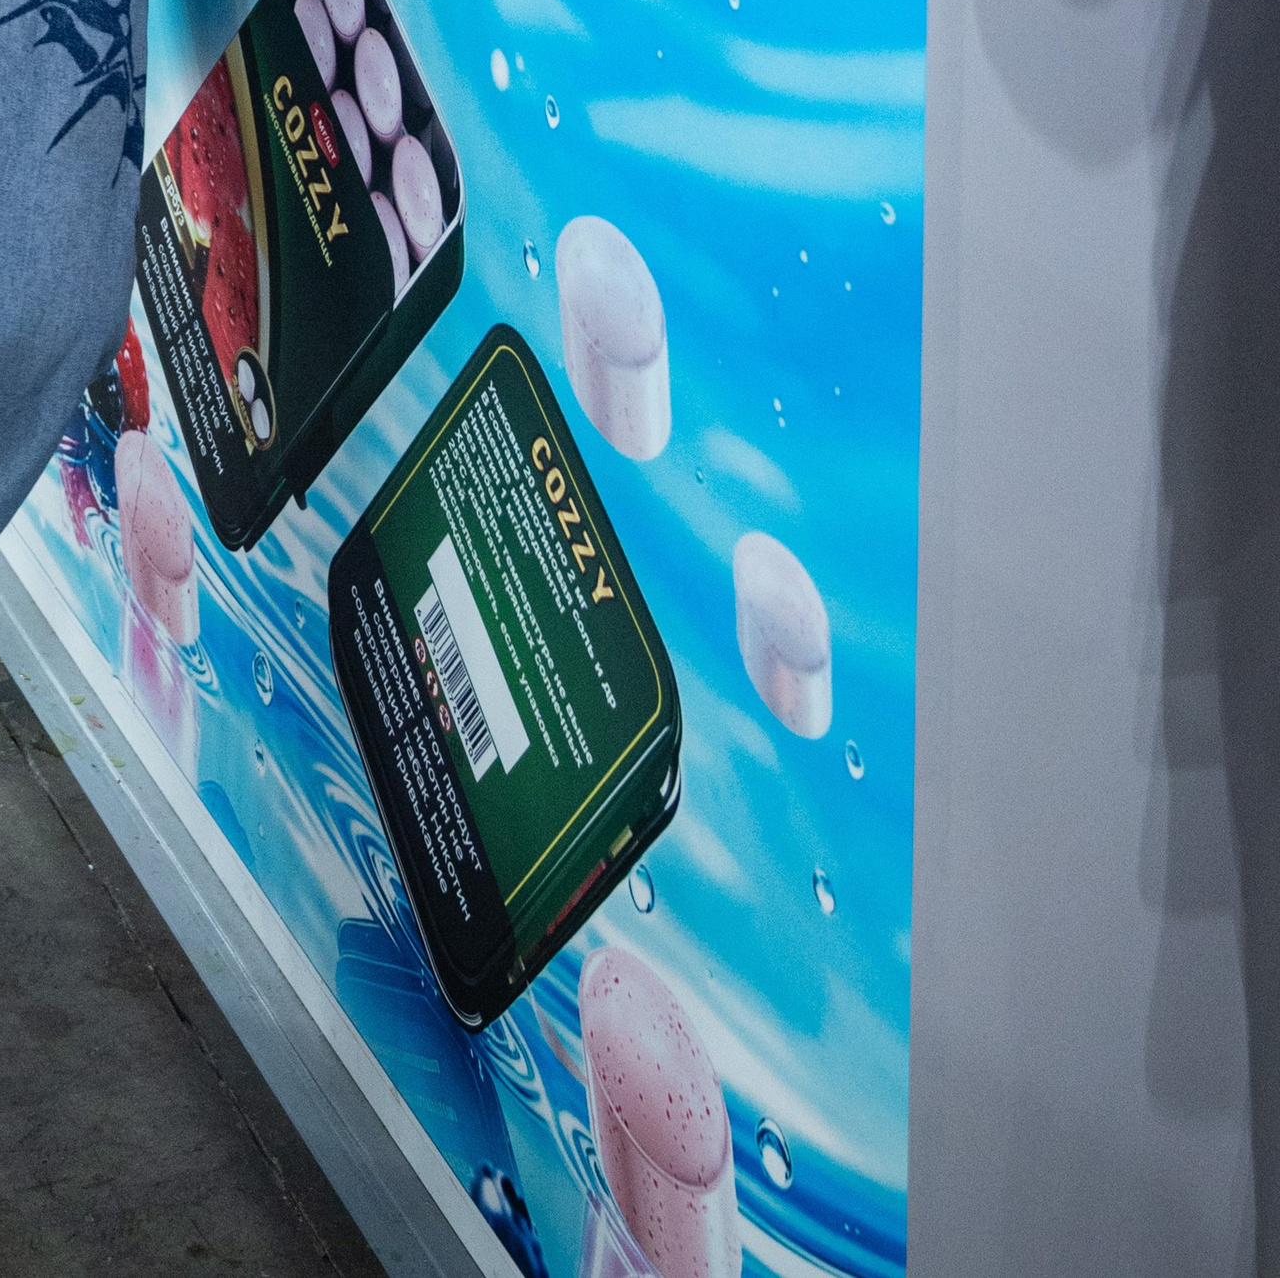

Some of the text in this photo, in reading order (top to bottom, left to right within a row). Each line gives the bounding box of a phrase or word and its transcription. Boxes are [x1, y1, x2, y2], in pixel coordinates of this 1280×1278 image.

[163, 170, 185, 229] арбуз
[263, 91, 332, 268] НИКОТИНОВЫЕ ЛЕДЕНЦЫ
[272, 74, 349, 244] COZZY
[140, 221, 179, 335] содержащий
[195, 393, 224, 476] Никотин
[142, 257, 207, 460] вызывает привыкание
[156, 240, 220, 431] содержит никотин не
[159, 215, 234, 439] Внимание: этот продукт
[427, 465, 476, 583] повреждена.
[440, 445, 468, 508] лучей.
[460, 418, 503, 517] Без табака
[467, 408, 501, 486] Никотин
[505, 500, 531, 557] мг/шт
[473, 400, 565, 615] пищевые ингредиенты
[480, 389, 617, 712] В составе никотиновая соль и др
[486, 379, 588, 613] Упаковка 20 штук по 2 мг
[530, 434, 616, 606] COZZY
[434, 455, 560, 769] Не использовать, если упаковка
[453, 427, 593, 766] Хранить при температуре не выше
[467, 484, 504, 569] избегать
[500, 570, 535, 650] прямых
[533, 651, 583, 769] солнечных
[349, 581, 472, 923] содержащий табак. Никотин
[352, 626, 448, 897] вызывает привыкание
[371, 609, 464, 863] содержит никотин не
[372, 577, 483, 876] Внимание: этот продукт
